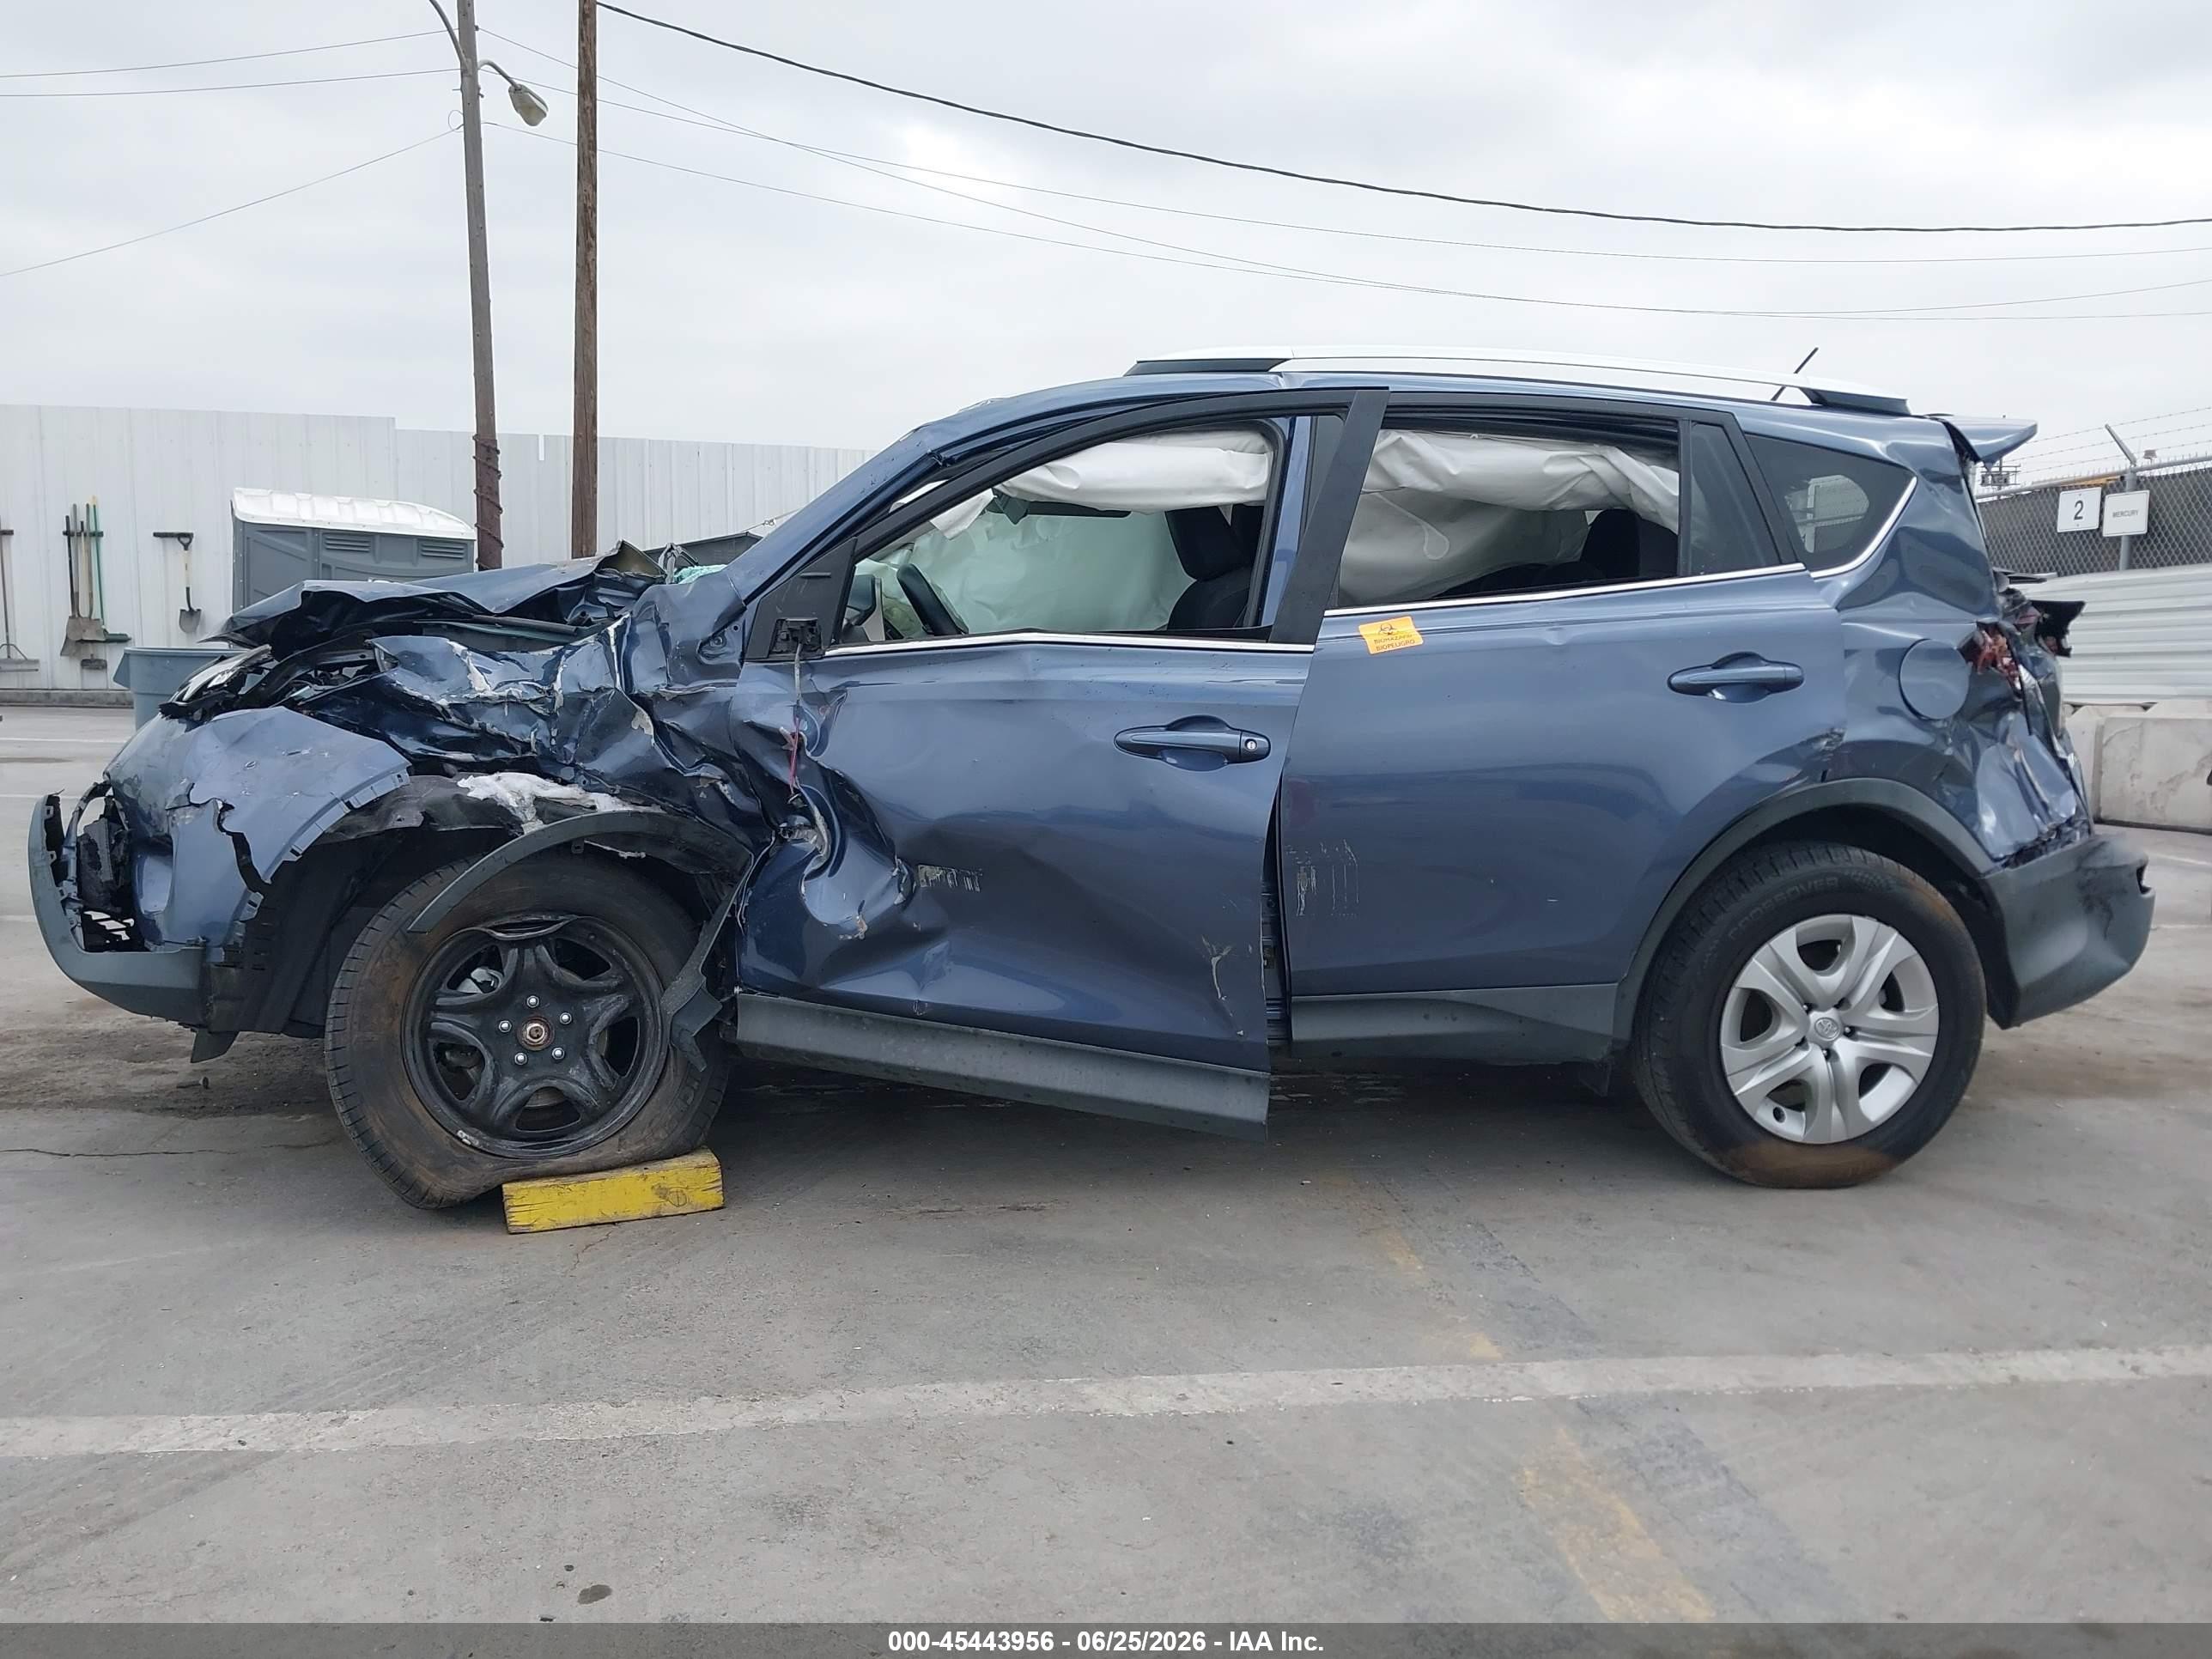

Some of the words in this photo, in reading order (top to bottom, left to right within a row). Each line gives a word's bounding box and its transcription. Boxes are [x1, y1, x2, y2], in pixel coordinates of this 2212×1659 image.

[2073, 500, 2084, 520] 2
[1376, 639, 1415, 651] BIOPELIGRO
[1727, 875, 1840, 940] CROSSOVER
